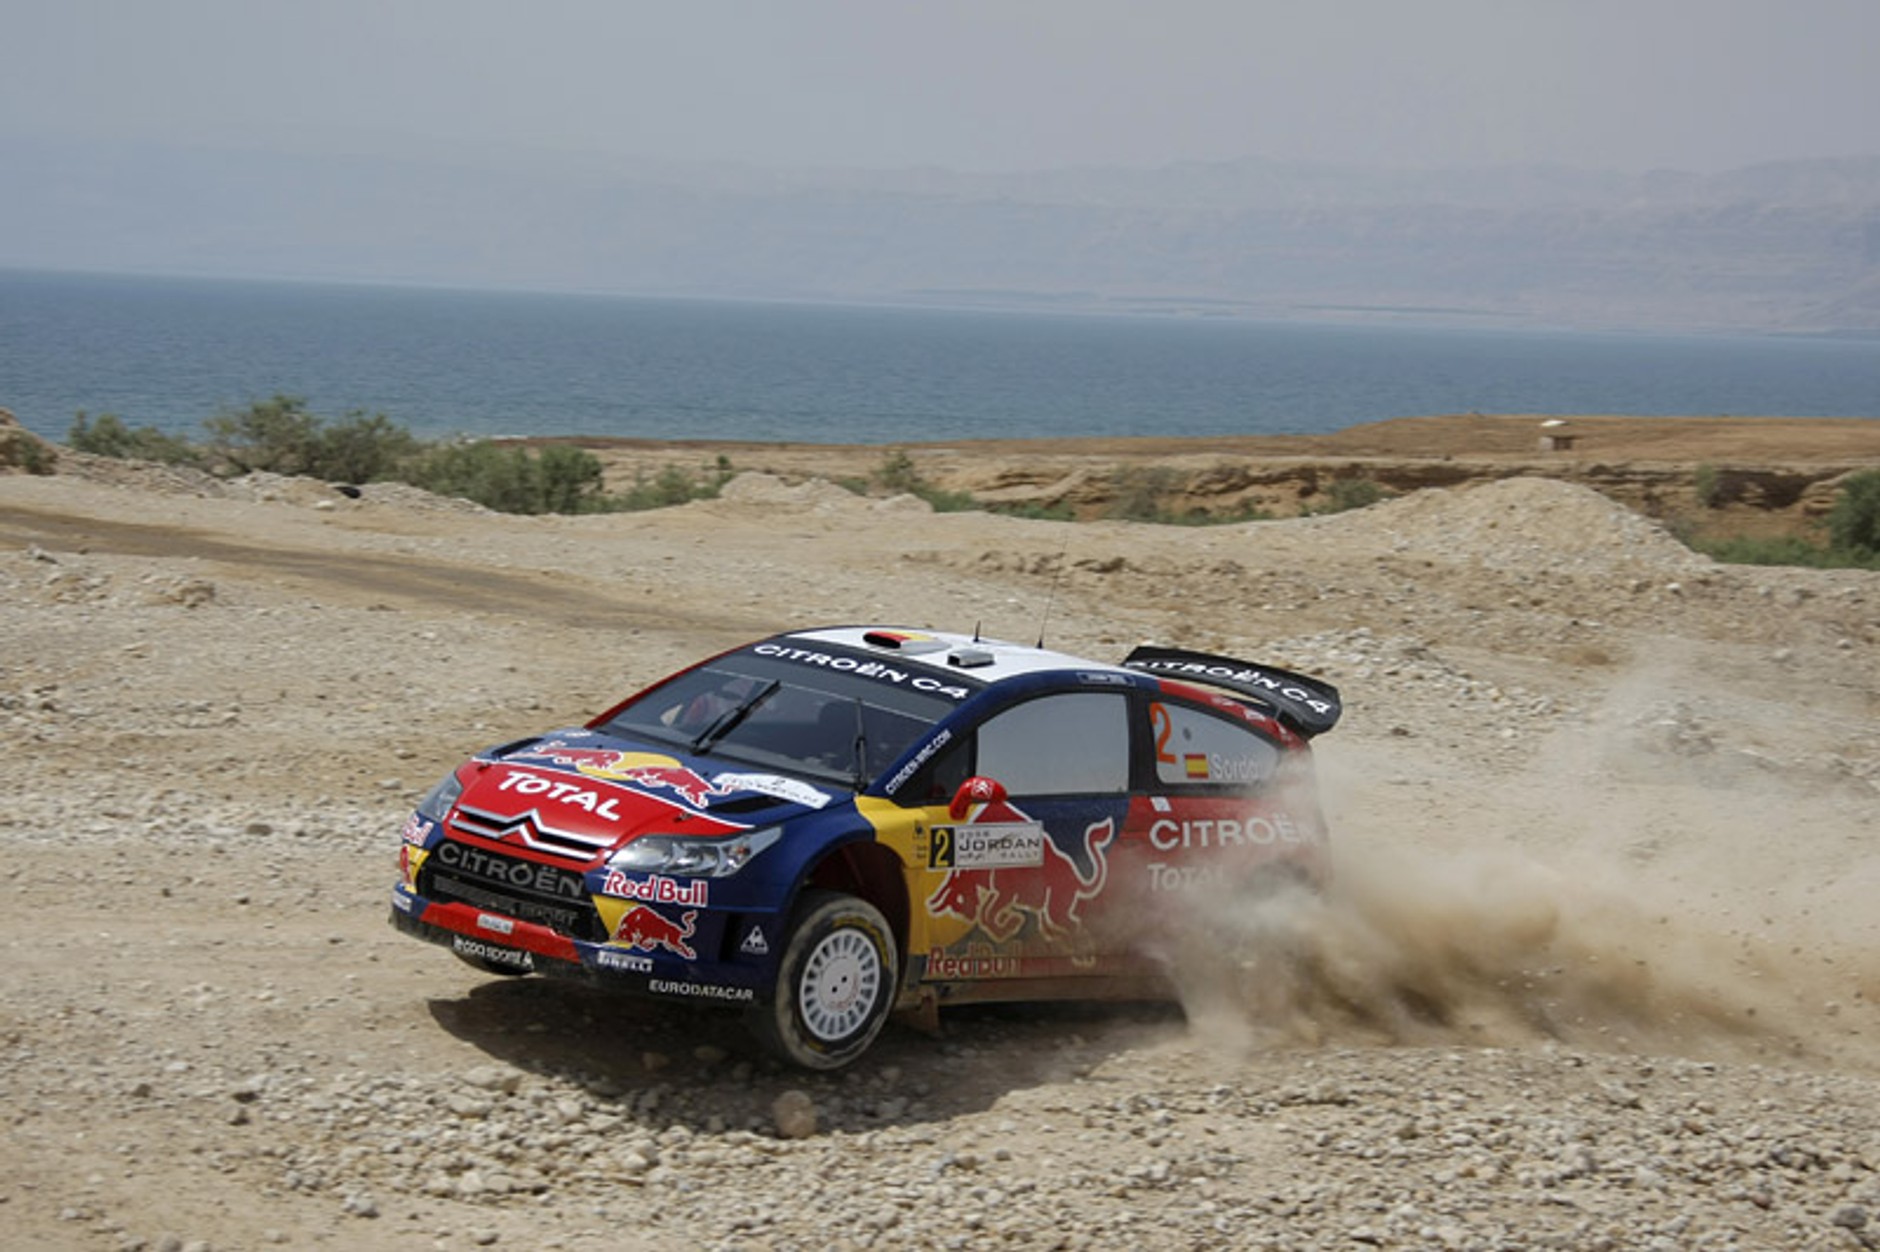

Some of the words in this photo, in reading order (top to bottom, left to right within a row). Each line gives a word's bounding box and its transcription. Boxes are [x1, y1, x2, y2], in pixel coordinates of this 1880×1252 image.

[754, 643, 908, 683] CITROËN
[912, 677, 970, 699] C4
[1282, 686, 1332, 715] C4
[1150, 701, 1177, 764] 2
[498, 770, 621, 821] TOTAL
[934, 828, 950, 867] 2
[958, 837, 1040, 852] JORDAN
[438, 841, 584, 898] CITROËN
[603, 870, 655, 900] Red
[656, 876, 709, 908] Bull
[926, 942, 975, 978] Red
[649, 978, 754, 1001] EURODATACAR
